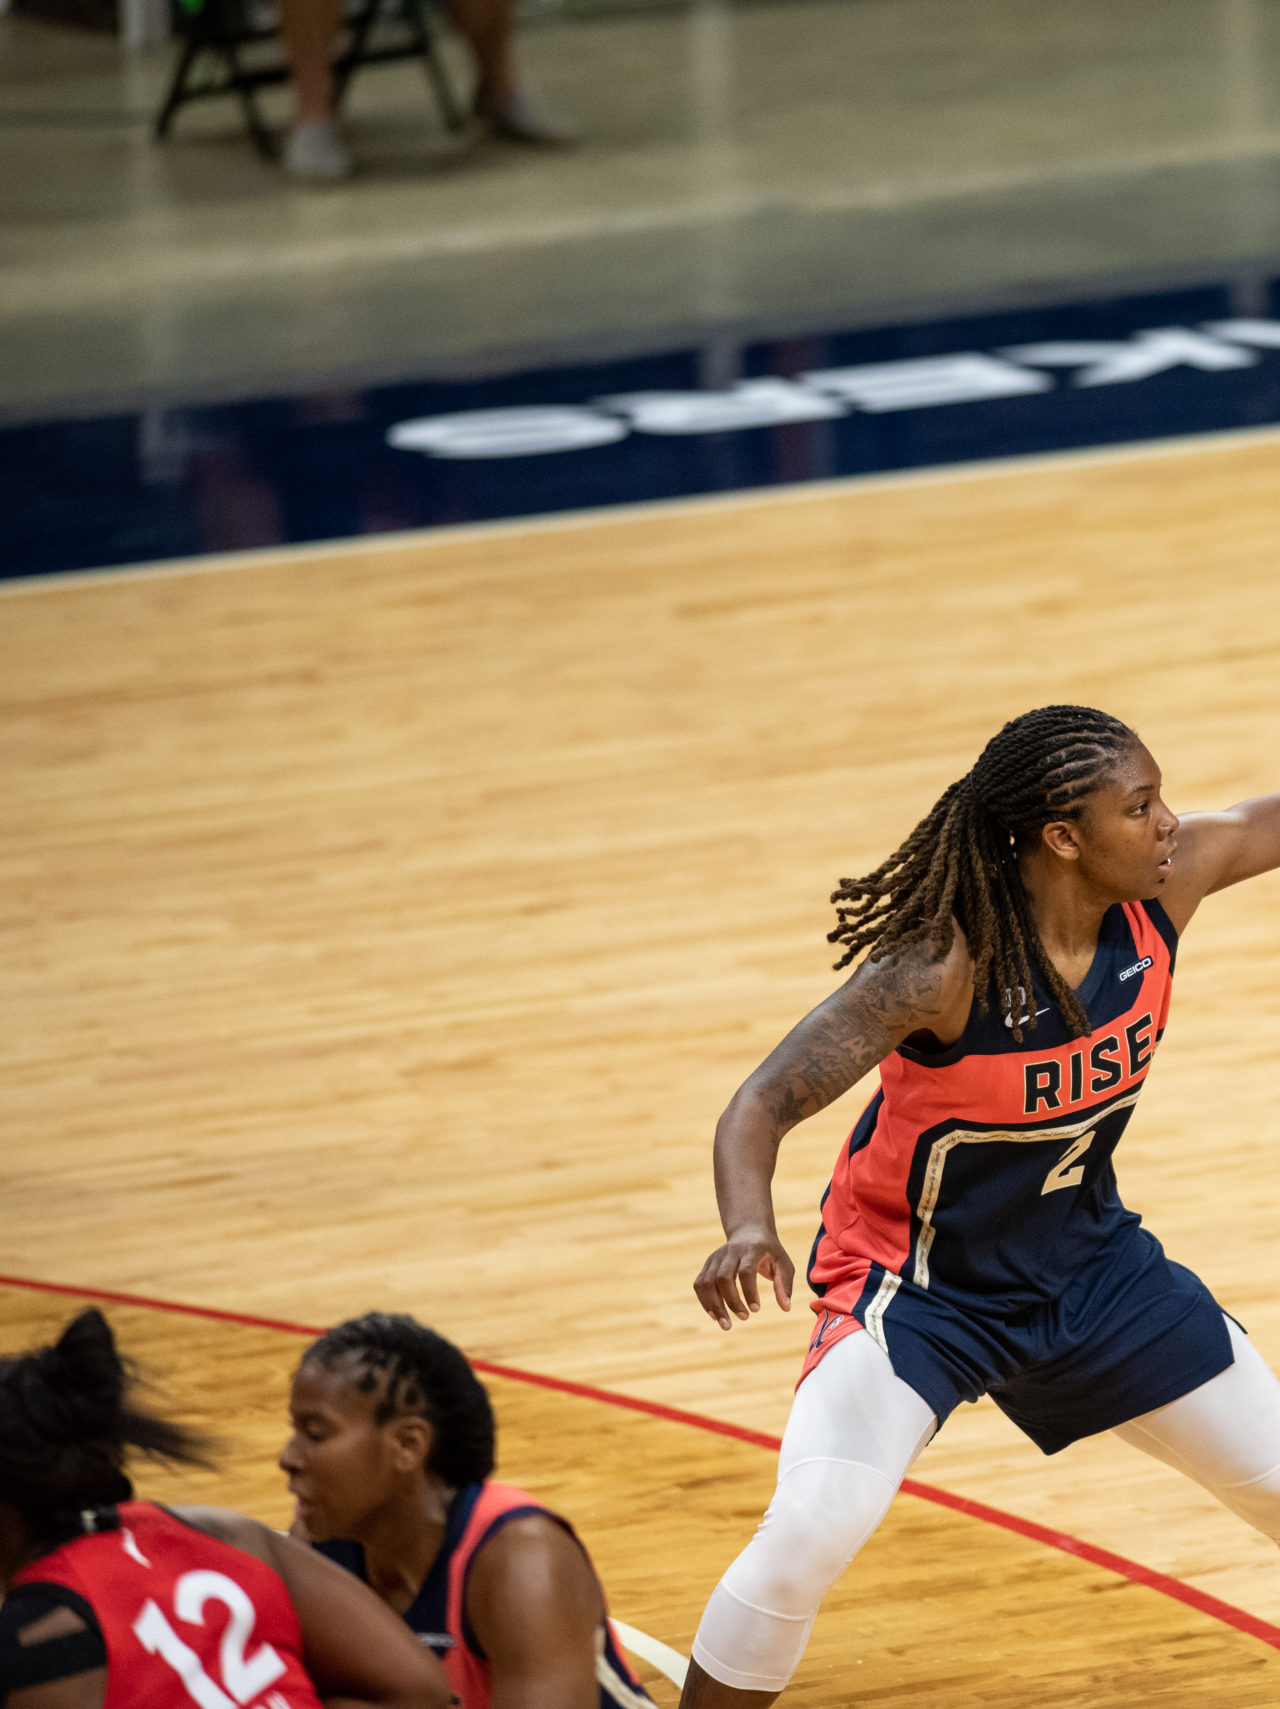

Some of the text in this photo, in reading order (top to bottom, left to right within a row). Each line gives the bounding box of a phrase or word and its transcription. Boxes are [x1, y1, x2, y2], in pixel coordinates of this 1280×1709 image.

[1119, 956, 1152, 982] GEICO
[1023, 1012, 1155, 1115] RISE
[1040, 1130, 1096, 1196] 2
[132, 1568, 288, 1709] 12
